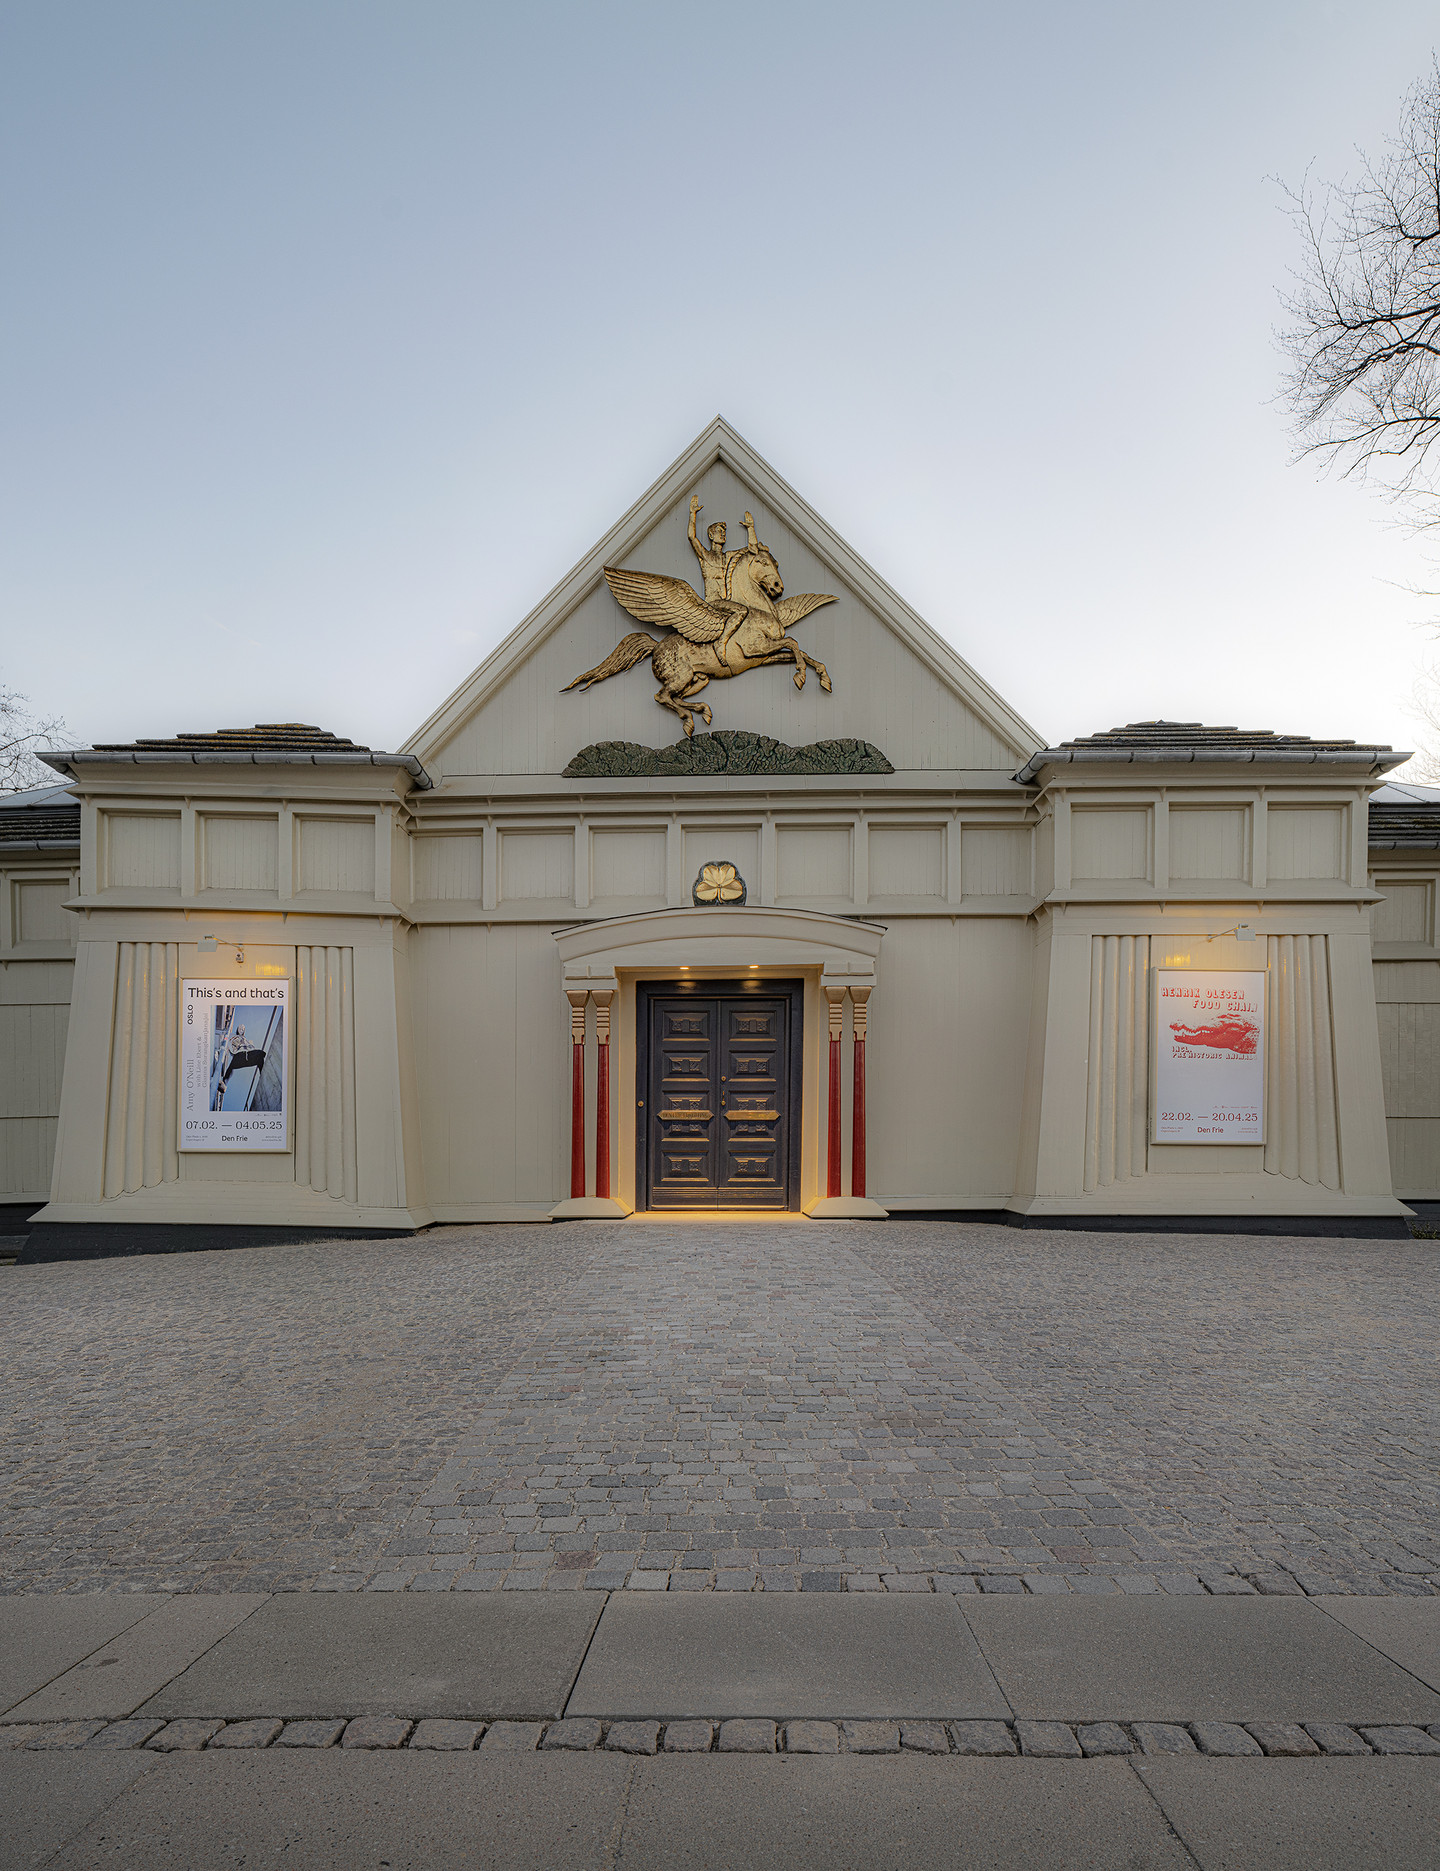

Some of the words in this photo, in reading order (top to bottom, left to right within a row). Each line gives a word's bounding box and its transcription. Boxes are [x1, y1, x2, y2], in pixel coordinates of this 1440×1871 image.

[187, 987, 222, 998] This's
[224, 987, 247, 998] and
[250, 987, 285, 998] that's
[1161, 986, 1200, 998] HENRIK
[1206, 989, 1245, 1000] OLESEN
[1192, 999, 1221, 1010] FOOD
[1226, 1001, 1258, 1013] CHAIN
[186, 1091, 195, 1112] Amy
[1161, 1112, 1194, 1121] 22.02.
[1212, 1112, 1258, 1122] 20.04.25
[185, 1120, 218, 1130] 07.02.
[235, 1120, 283, 1130] 04.05.25
[1212, 1126, 1224, 1134] Frie
